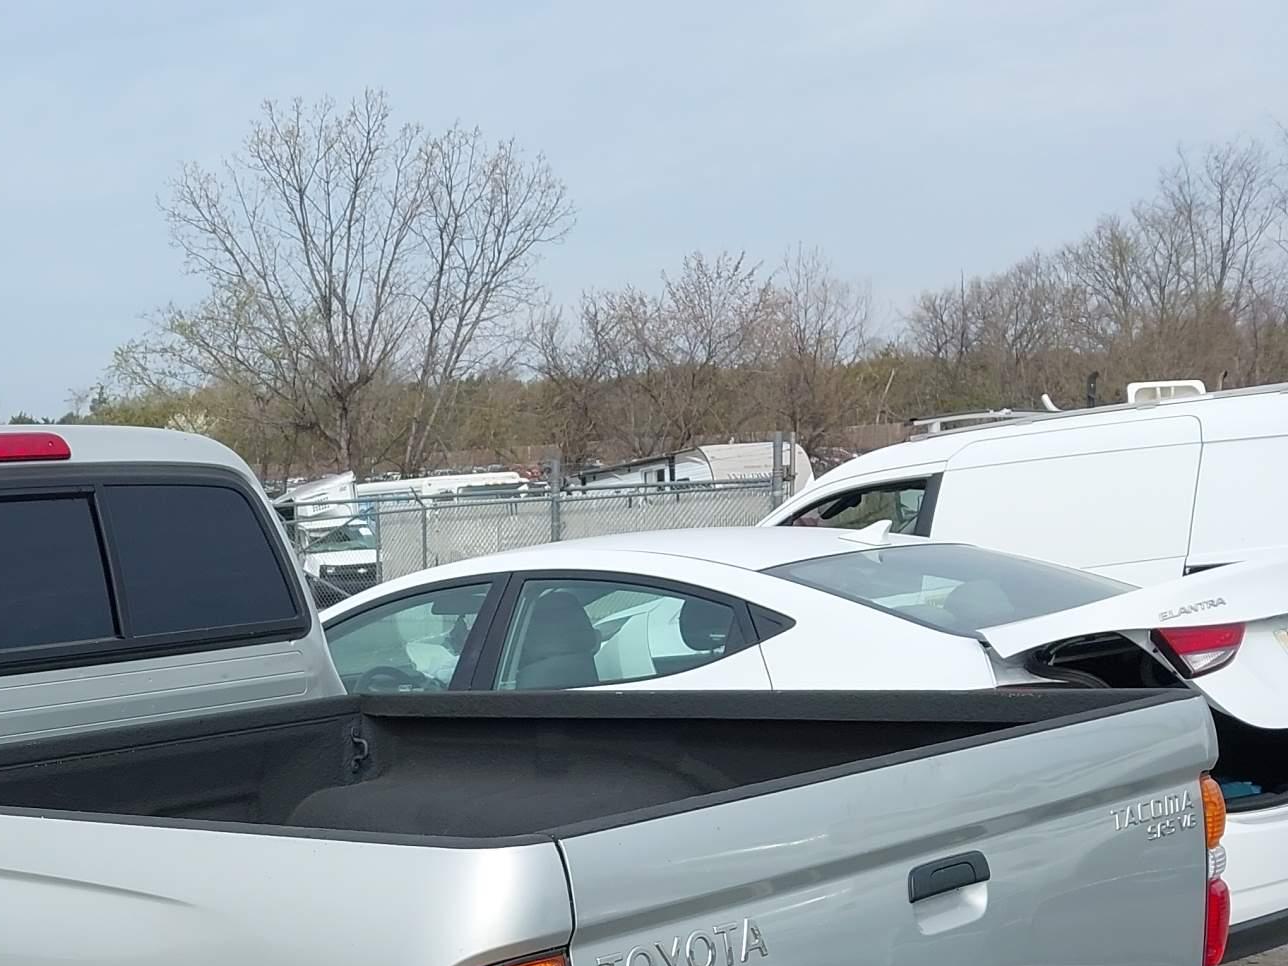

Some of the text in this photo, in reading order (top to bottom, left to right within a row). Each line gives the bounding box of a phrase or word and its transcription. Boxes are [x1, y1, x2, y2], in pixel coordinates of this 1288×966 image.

[1158, 597, 1227, 622] ELANTRA
[1110, 789, 1195, 832] TACOMA
[1146, 813, 1197, 841] SR5 V6
